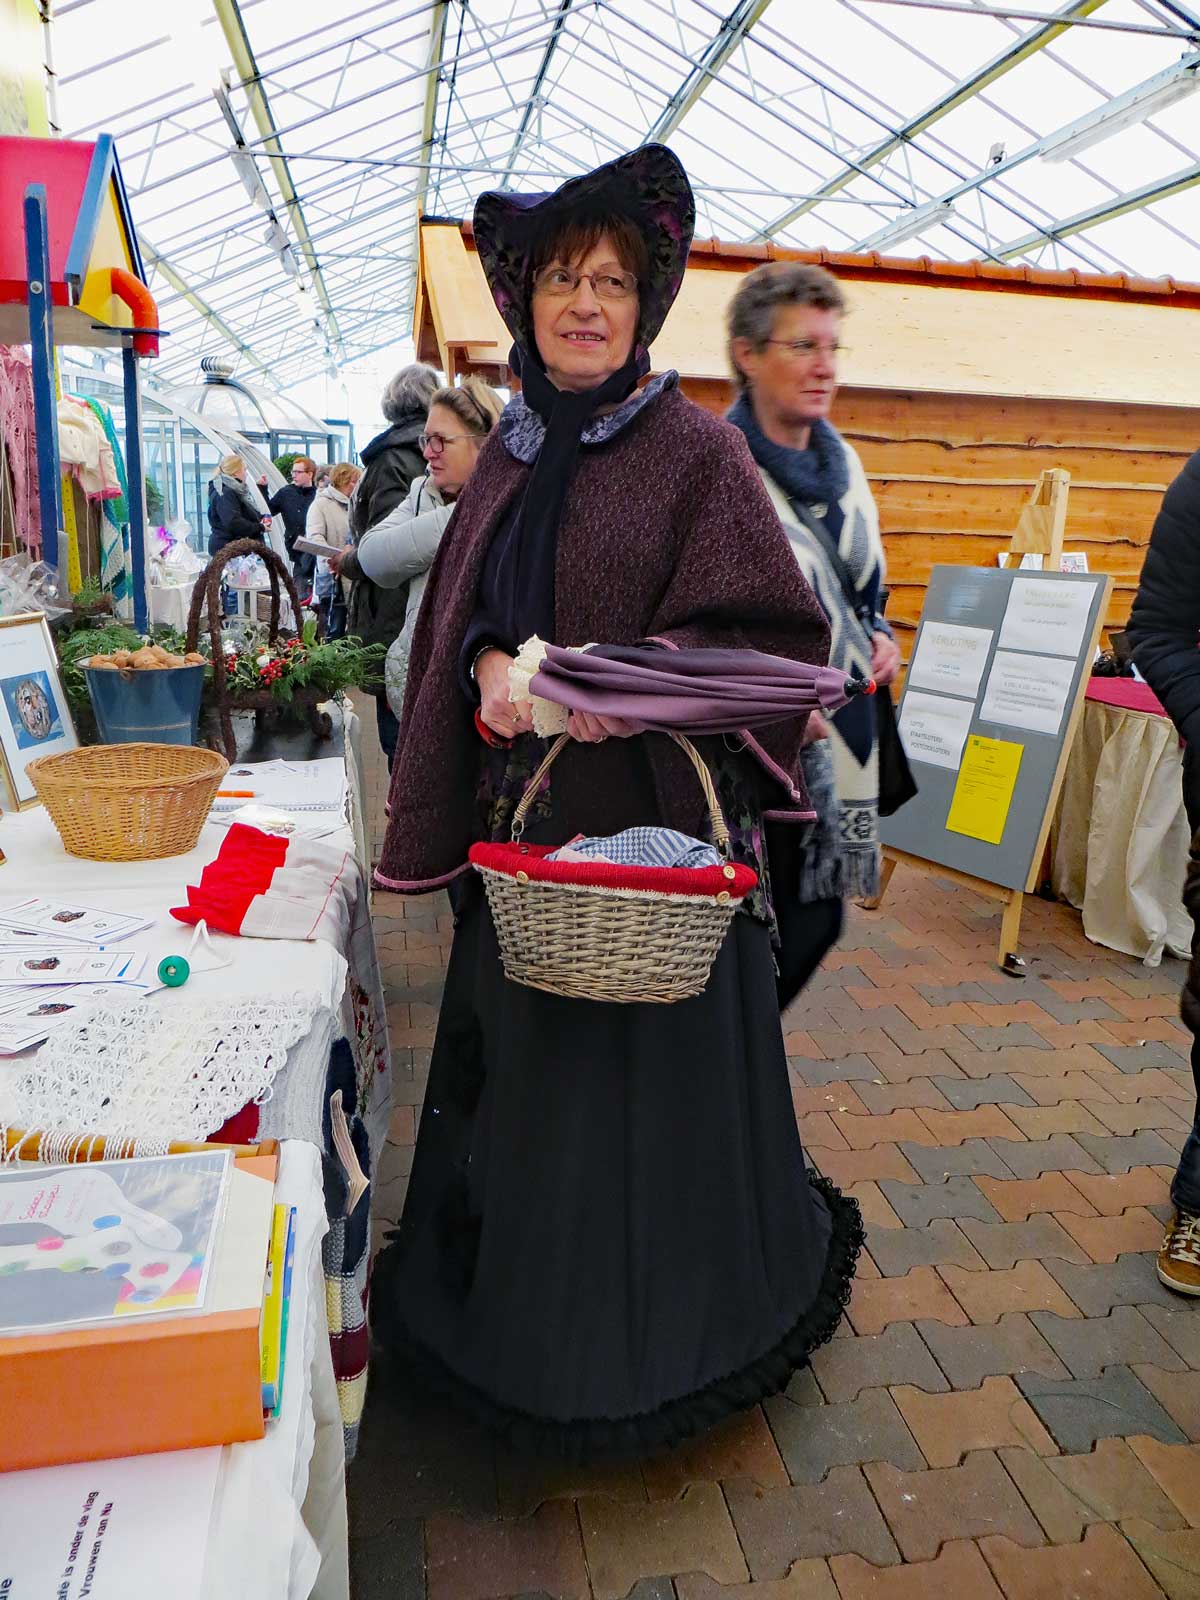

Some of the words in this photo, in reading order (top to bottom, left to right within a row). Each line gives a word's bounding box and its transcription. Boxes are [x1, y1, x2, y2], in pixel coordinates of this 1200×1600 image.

[82, 1491, 99, 1513] vlag
[100, 1502, 113, 1517] Nu
[78, 1515, 89, 1528] de
[96, 1519, 108, 1538] van
[68, 1530, 84, 1562] onder
[61, 1565, 74, 1578] is
[79, 1540, 101, 1599] Vrouwen
